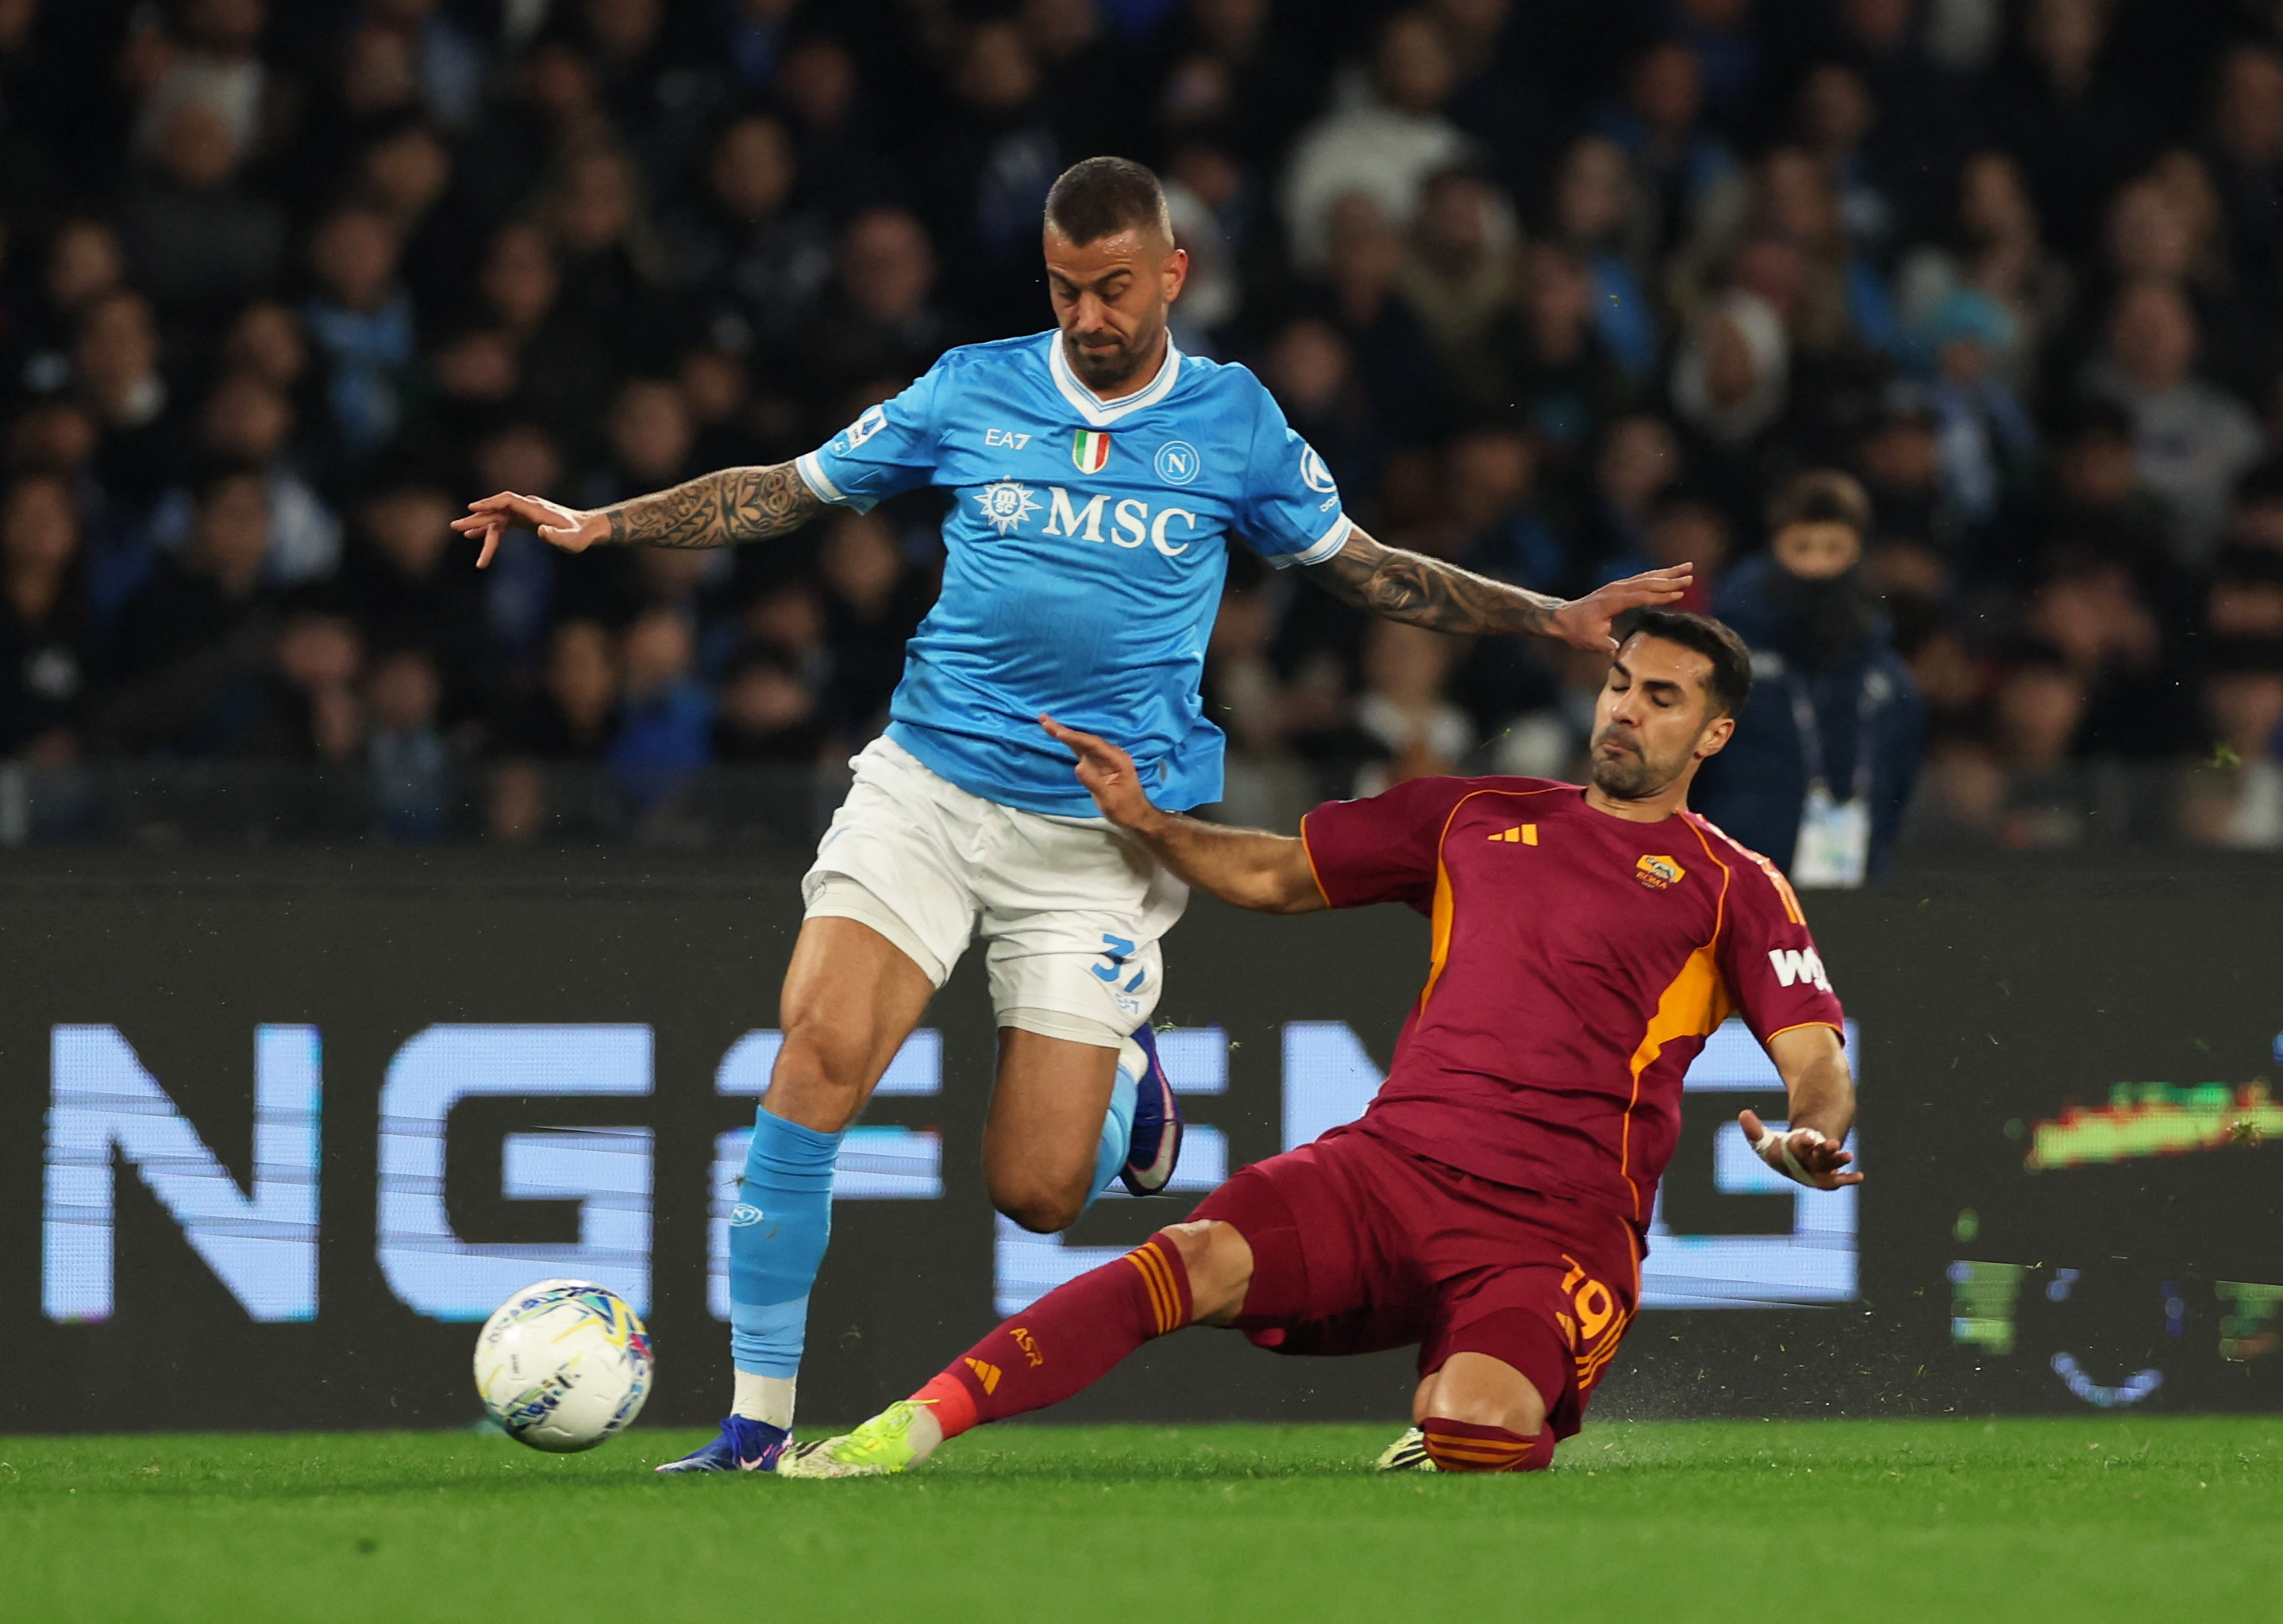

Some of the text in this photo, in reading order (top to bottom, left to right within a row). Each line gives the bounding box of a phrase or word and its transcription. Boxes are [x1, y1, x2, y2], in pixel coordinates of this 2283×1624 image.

[984, 428, 1031, 450] EA7
[1167, 453, 1187, 474] N
[1041, 486, 1195, 556] MSC
[1561, 1253, 1614, 1340] 19
[1009, 1327, 1044, 1368] ASR
